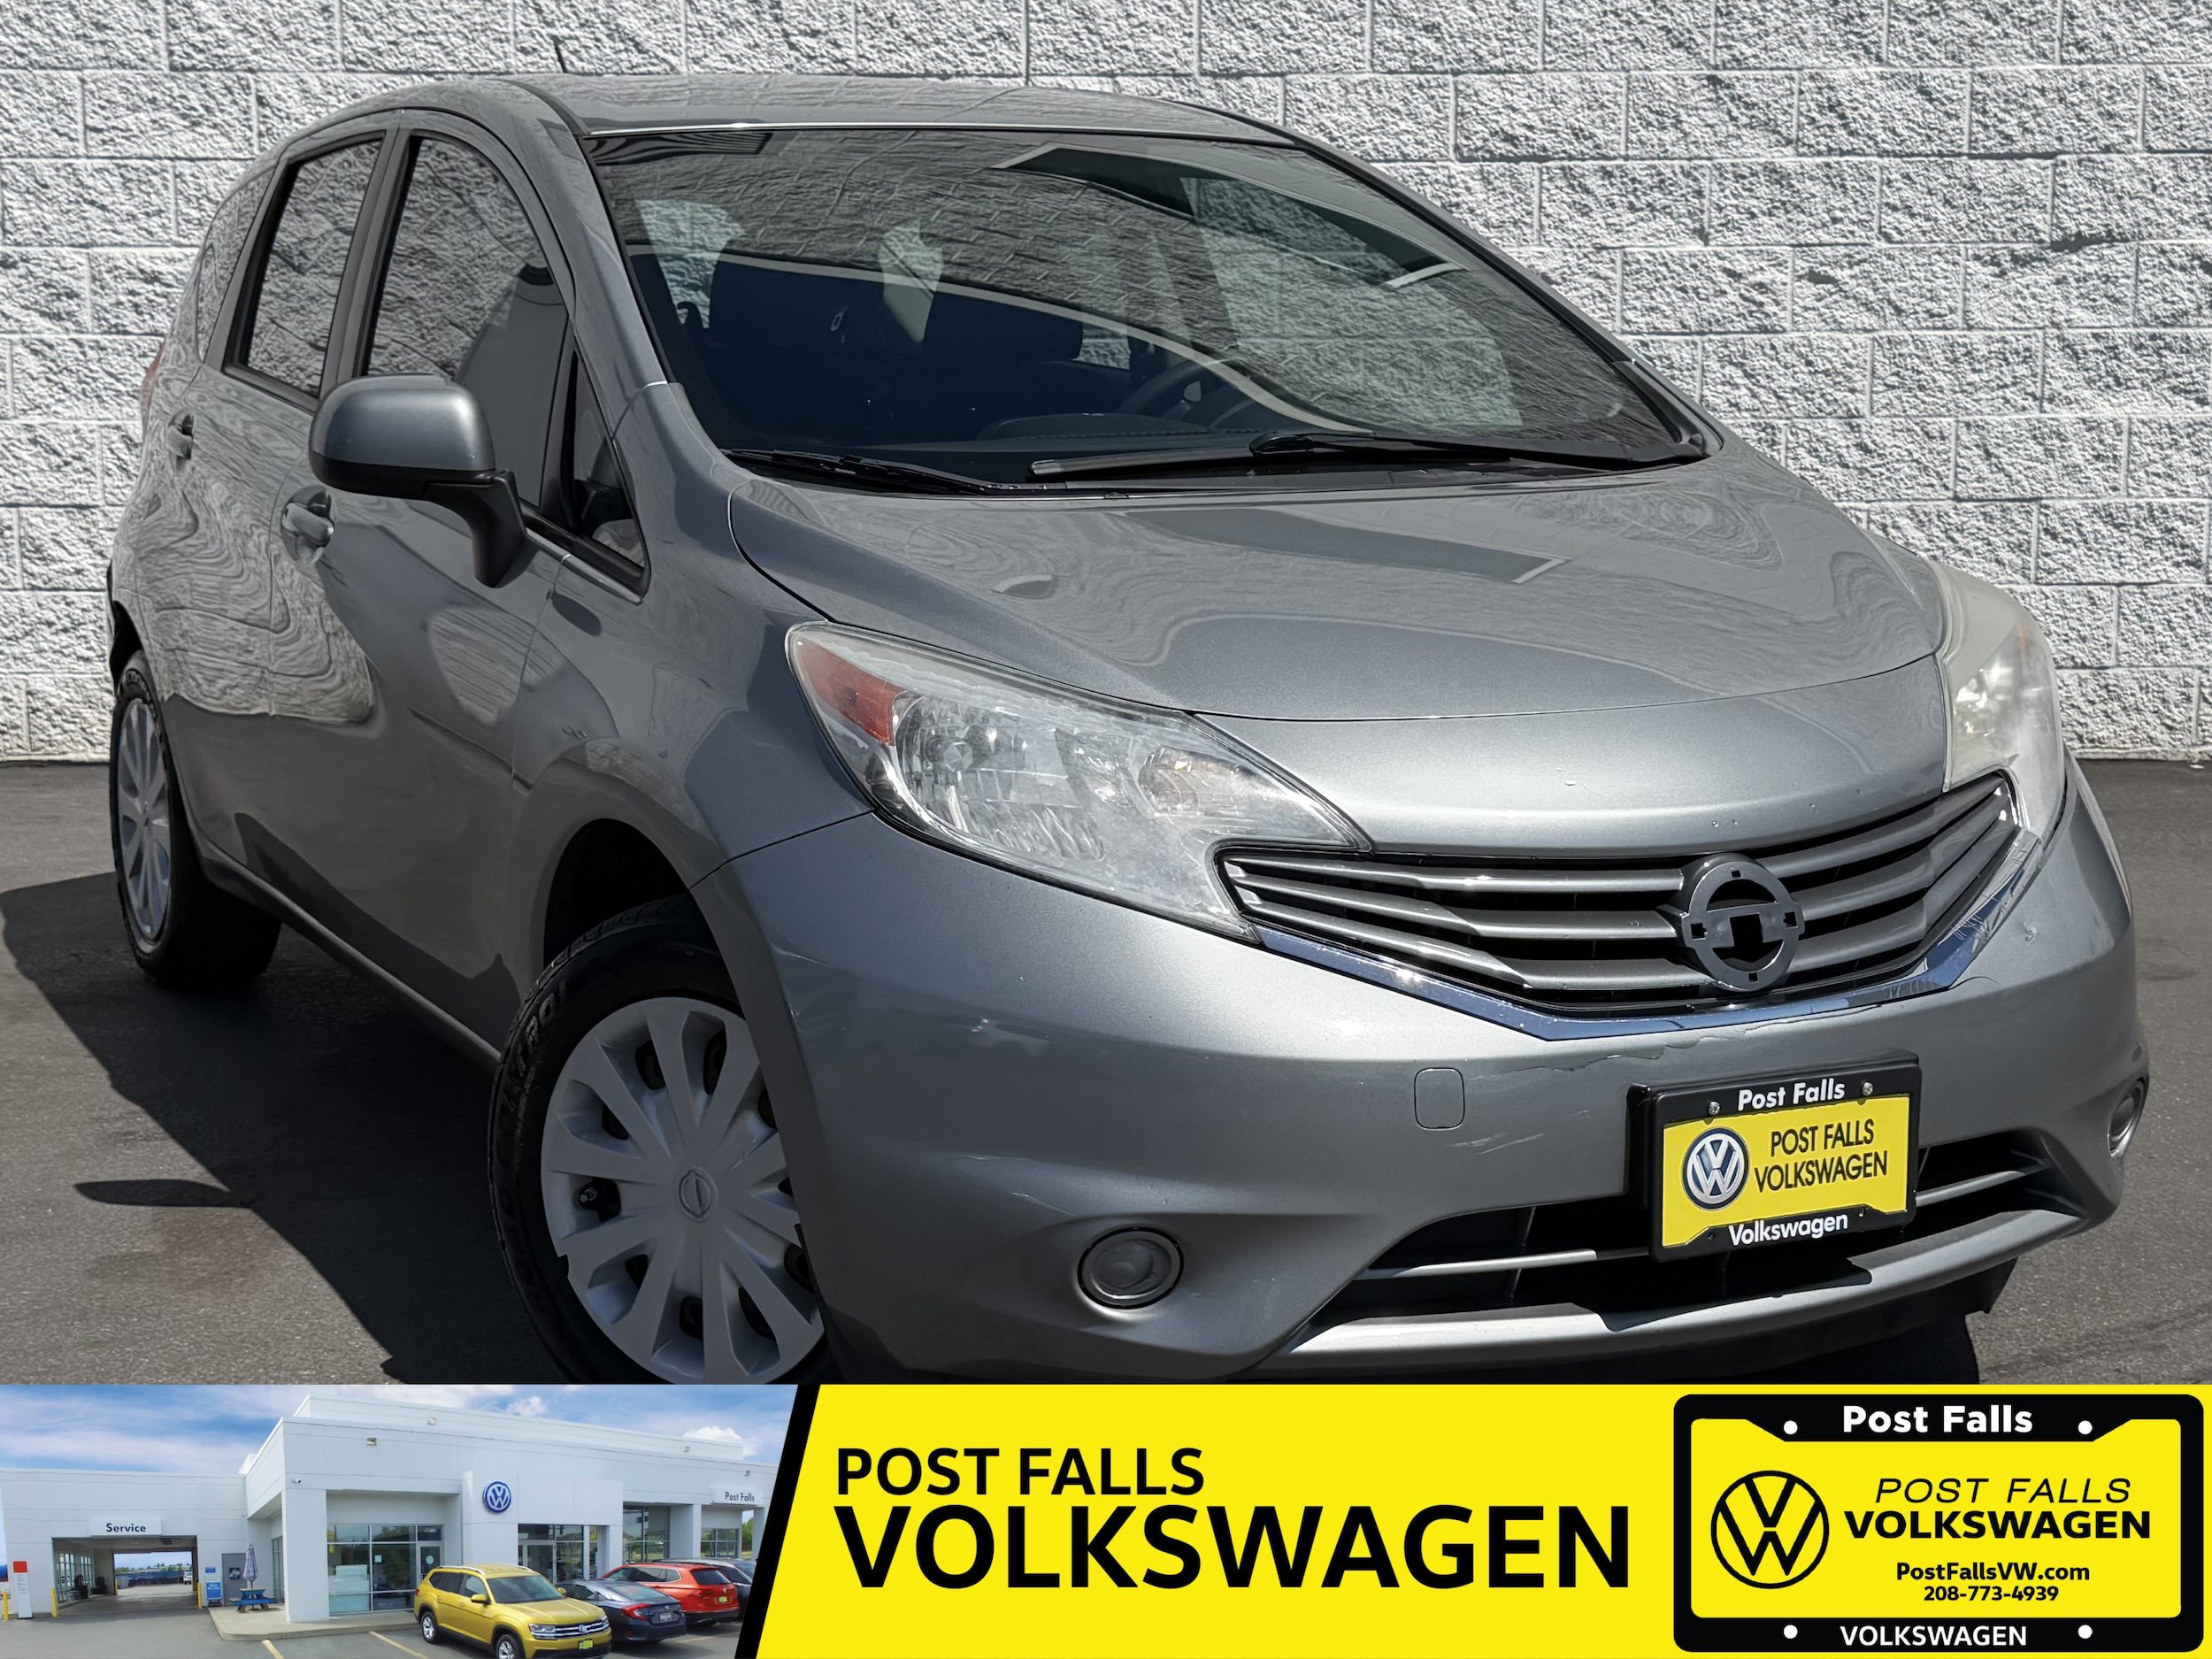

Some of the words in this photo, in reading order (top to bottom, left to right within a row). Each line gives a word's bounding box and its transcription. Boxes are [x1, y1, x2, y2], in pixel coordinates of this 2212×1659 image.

[1738, 1087, 1786, 1110] Post
[1793, 1078, 1845, 1104] Falls
[1770, 1125, 1818, 1156] POST
[1824, 1118, 1874, 1150] FALLS
[1755, 1150, 1888, 1193] VOLKSWAGEN
[1728, 1214, 1847, 1246] Volkswagen
[725, 1491, 739, 1502] Post
[740, 1492, 756, 1502] Falls
[106, 1523, 146, 1532] Service
